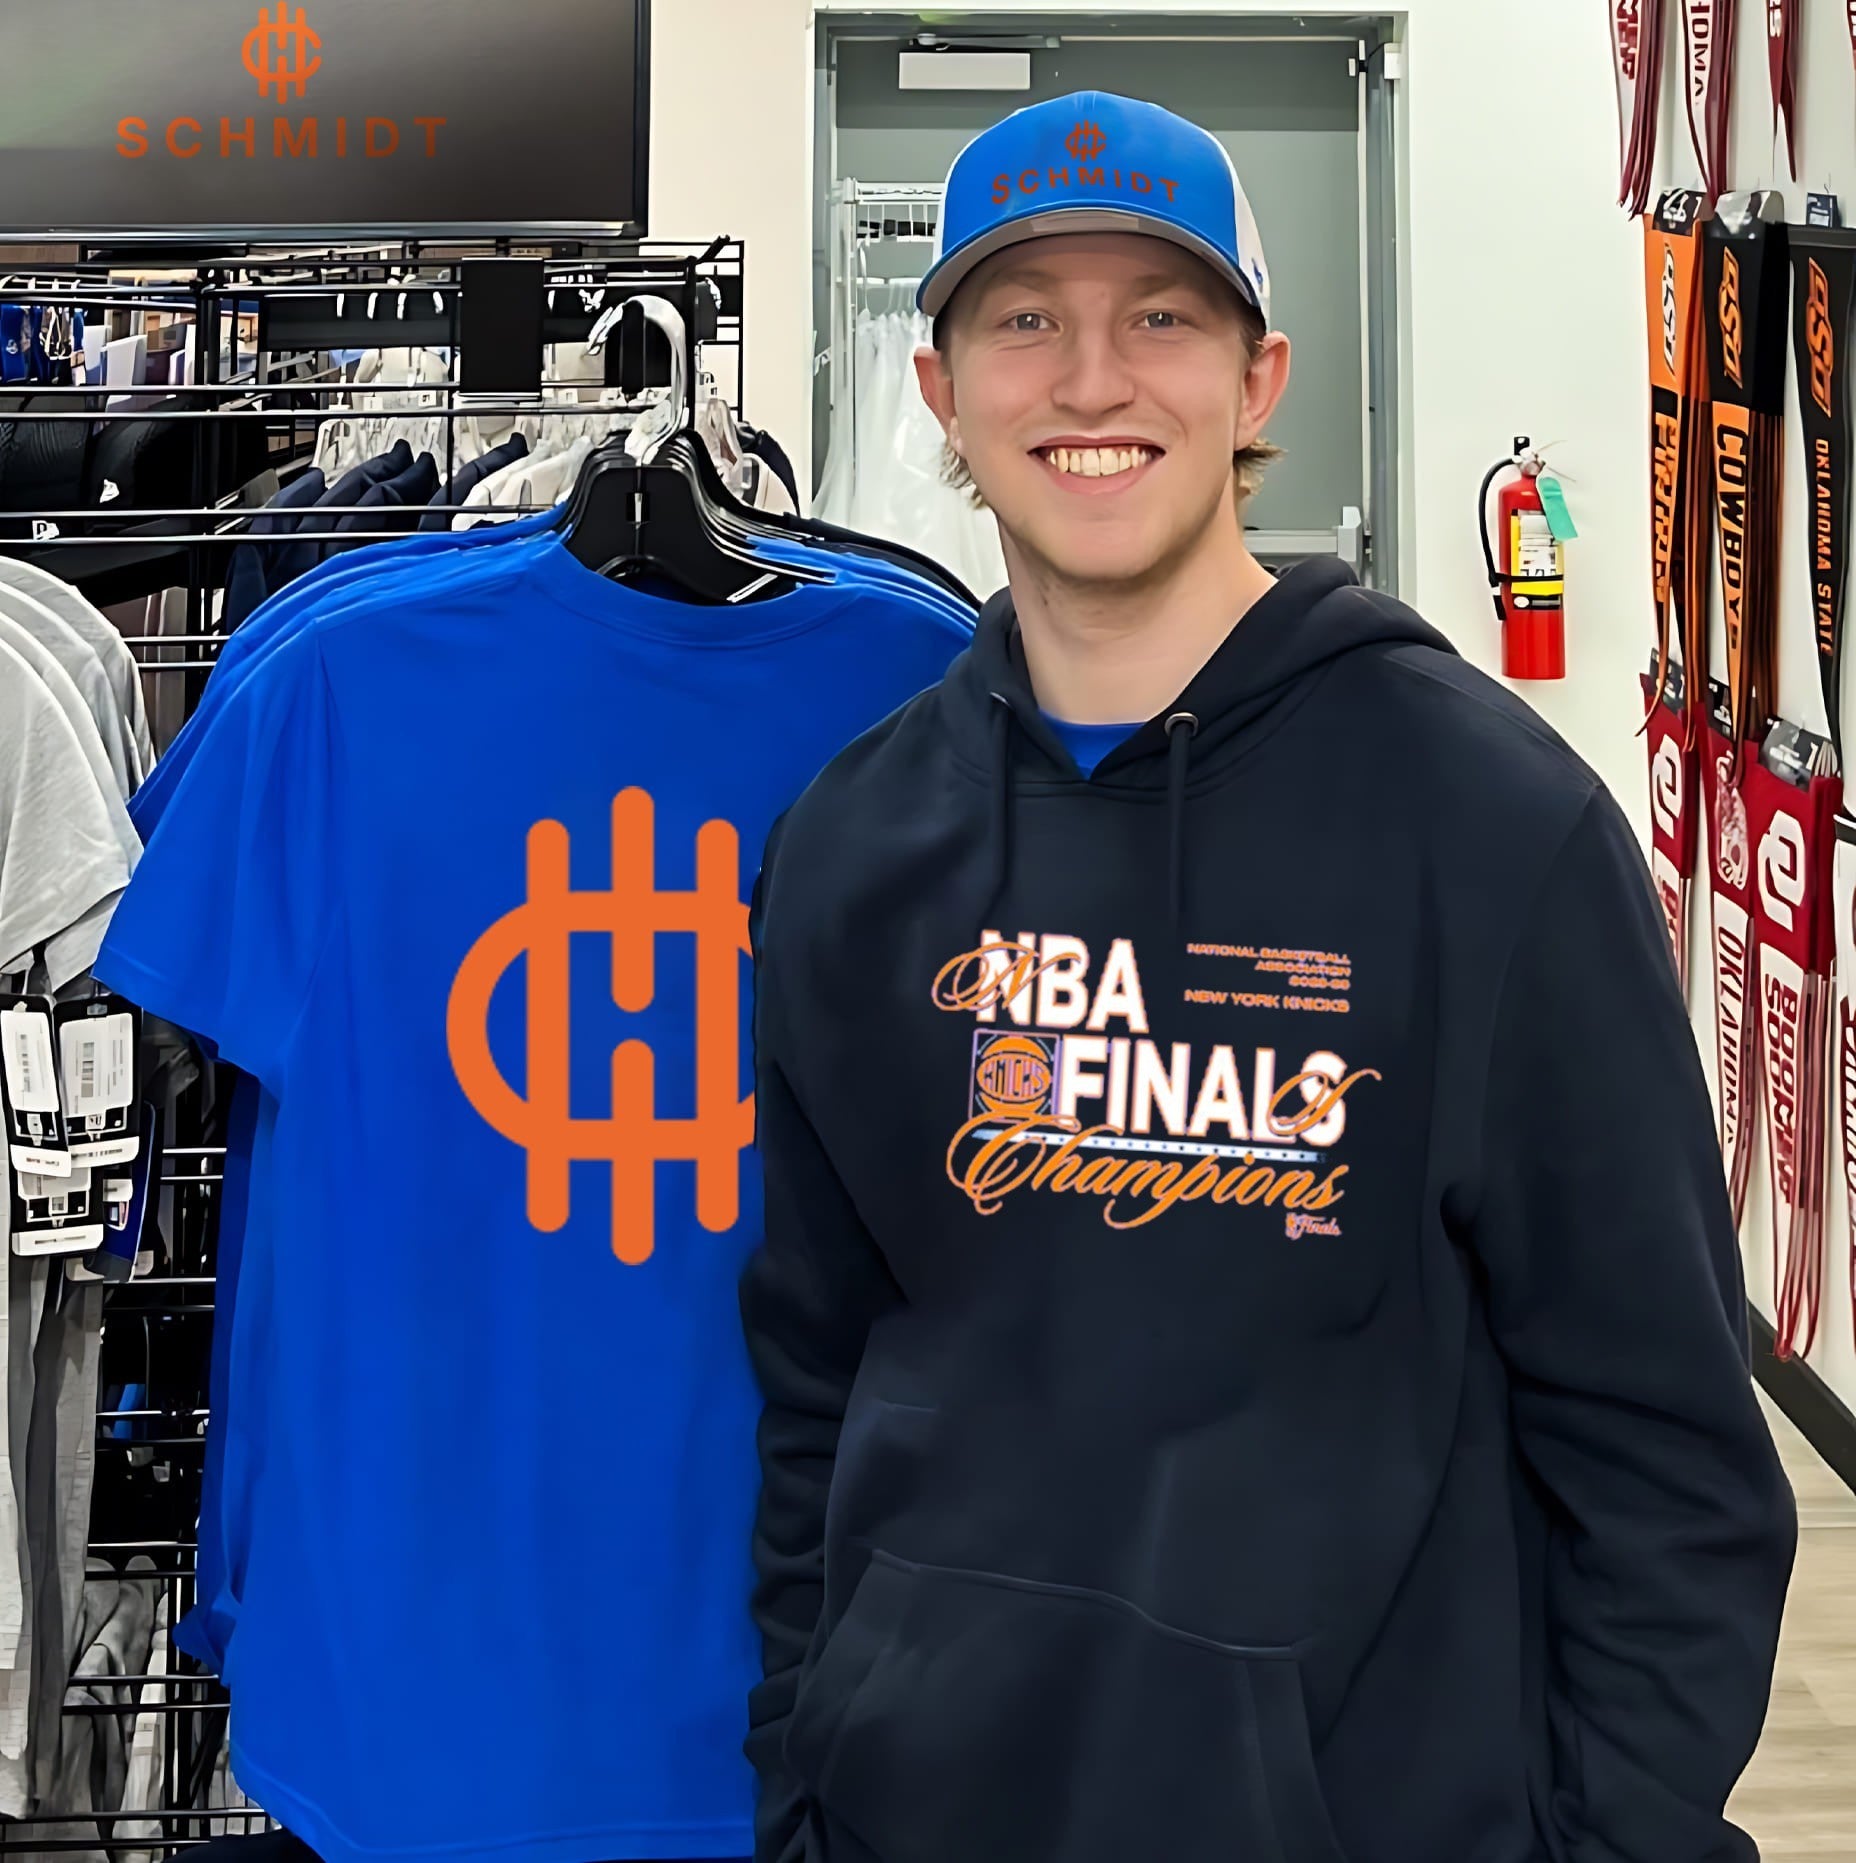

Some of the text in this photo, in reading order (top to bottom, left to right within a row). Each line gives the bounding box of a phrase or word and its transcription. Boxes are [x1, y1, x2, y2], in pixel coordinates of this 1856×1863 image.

[116, 116, 448, 159] SCHMIDT
[991, 166, 1180, 205] SCHMIDT
[1815, 438, 1832, 570] OKLAHOMA
[1186, 943, 1352, 966] NATIONAL BASKETBALL
[1254, 960, 1352, 978] ASSOCIATION
[976, 929, 1149, 1033] NBA
[1184, 989, 1350, 1014] NEW YORK KNICKS
[1062, 1034, 1347, 1148] FINALS
[946, 1110, 1350, 1230] Champions
